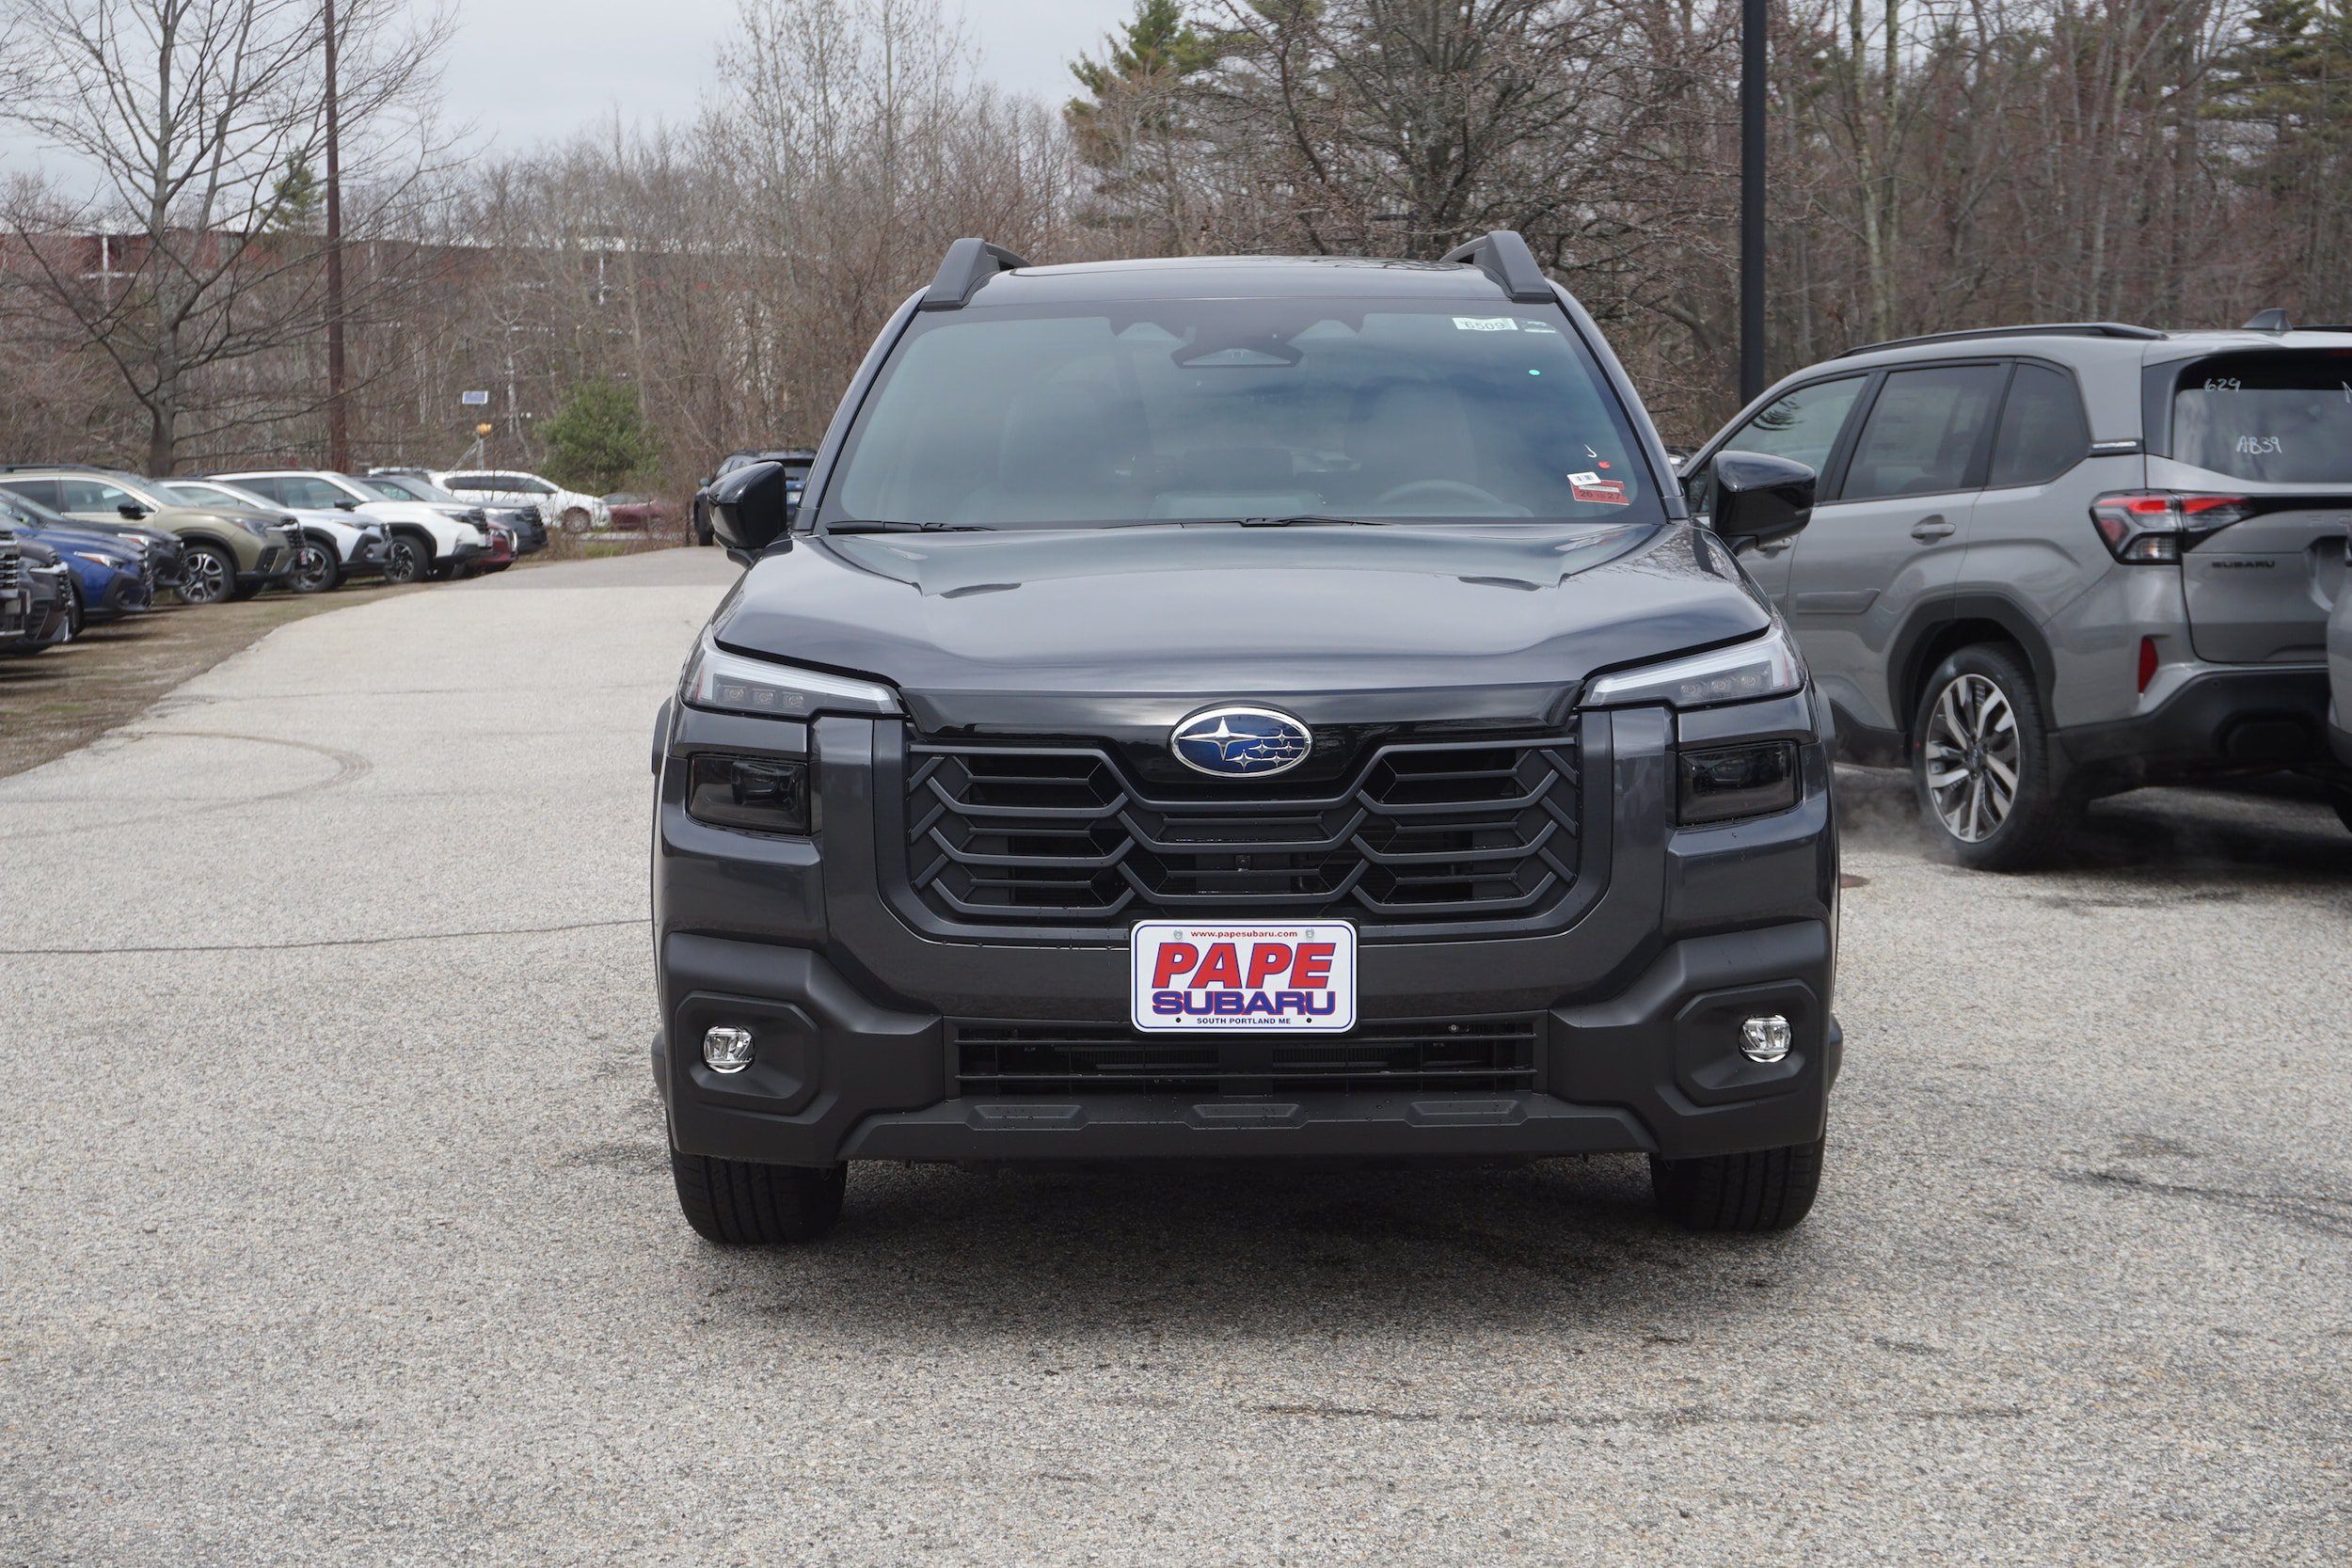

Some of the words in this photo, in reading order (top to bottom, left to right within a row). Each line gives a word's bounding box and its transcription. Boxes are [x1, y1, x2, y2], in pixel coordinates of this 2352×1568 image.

[2203, 377, 2241, 392] 629
[2235, 435, 2282, 454] AB39
[1190, 930, 1298, 939] www.papesubaru.com
[1152, 942, 1336, 989] PAPE
[1152, 990, 1336, 1016] SUBARU
